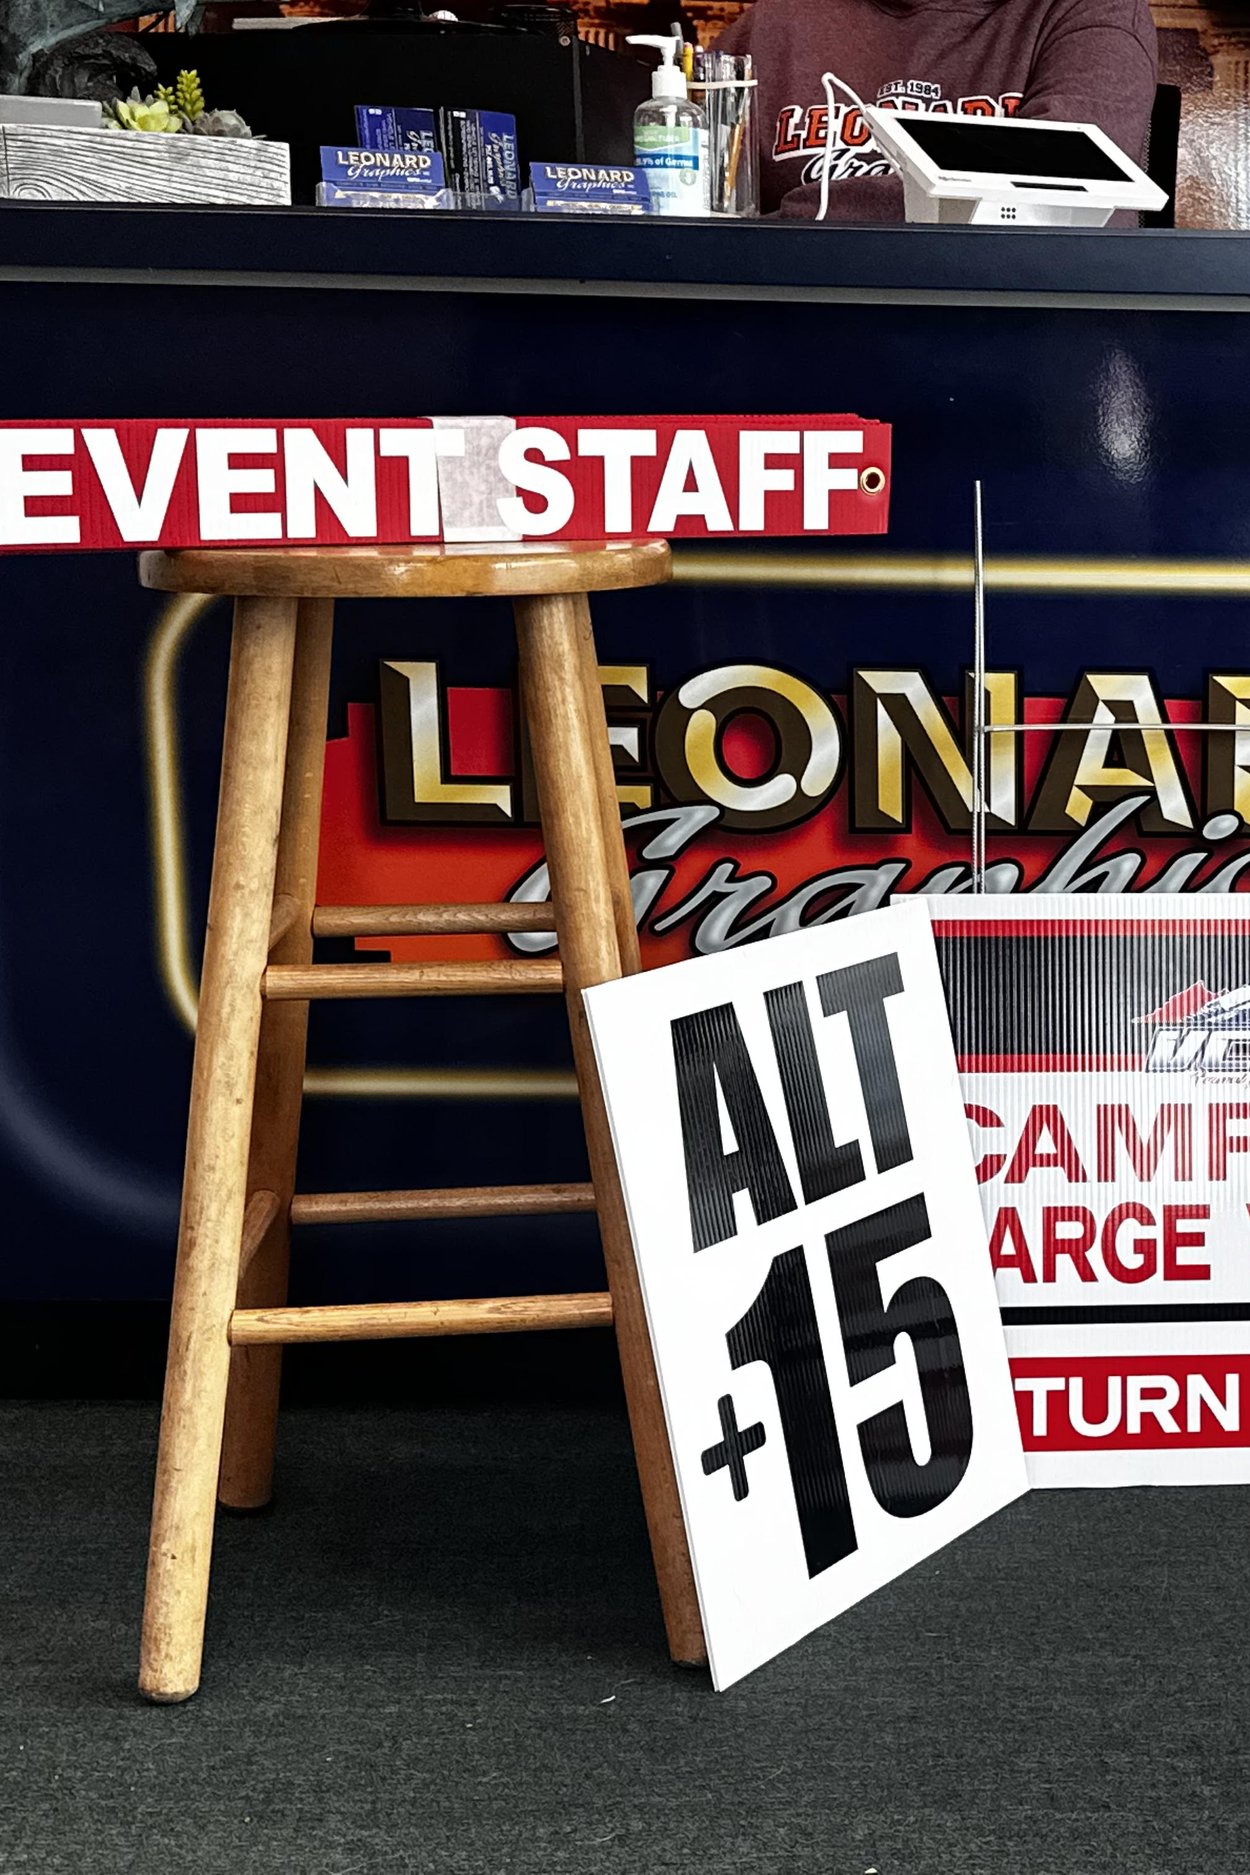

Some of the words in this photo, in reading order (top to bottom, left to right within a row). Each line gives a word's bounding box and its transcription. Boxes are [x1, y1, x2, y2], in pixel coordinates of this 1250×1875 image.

[907, 80, 941, 99] 1984
[337, 150, 431, 169] LEONARD
[545, 166, 634, 183] LEONARD
[0, 427, 466, 544] EVENT
[496, 427, 864, 536] STAFF
[670, 952, 914, 1253] ALT
[988, 1201, 1211, 1284] ARGE
[701, 1192, 973, 1580] +15
[1014, 1371, 1240, 1439] TURN
